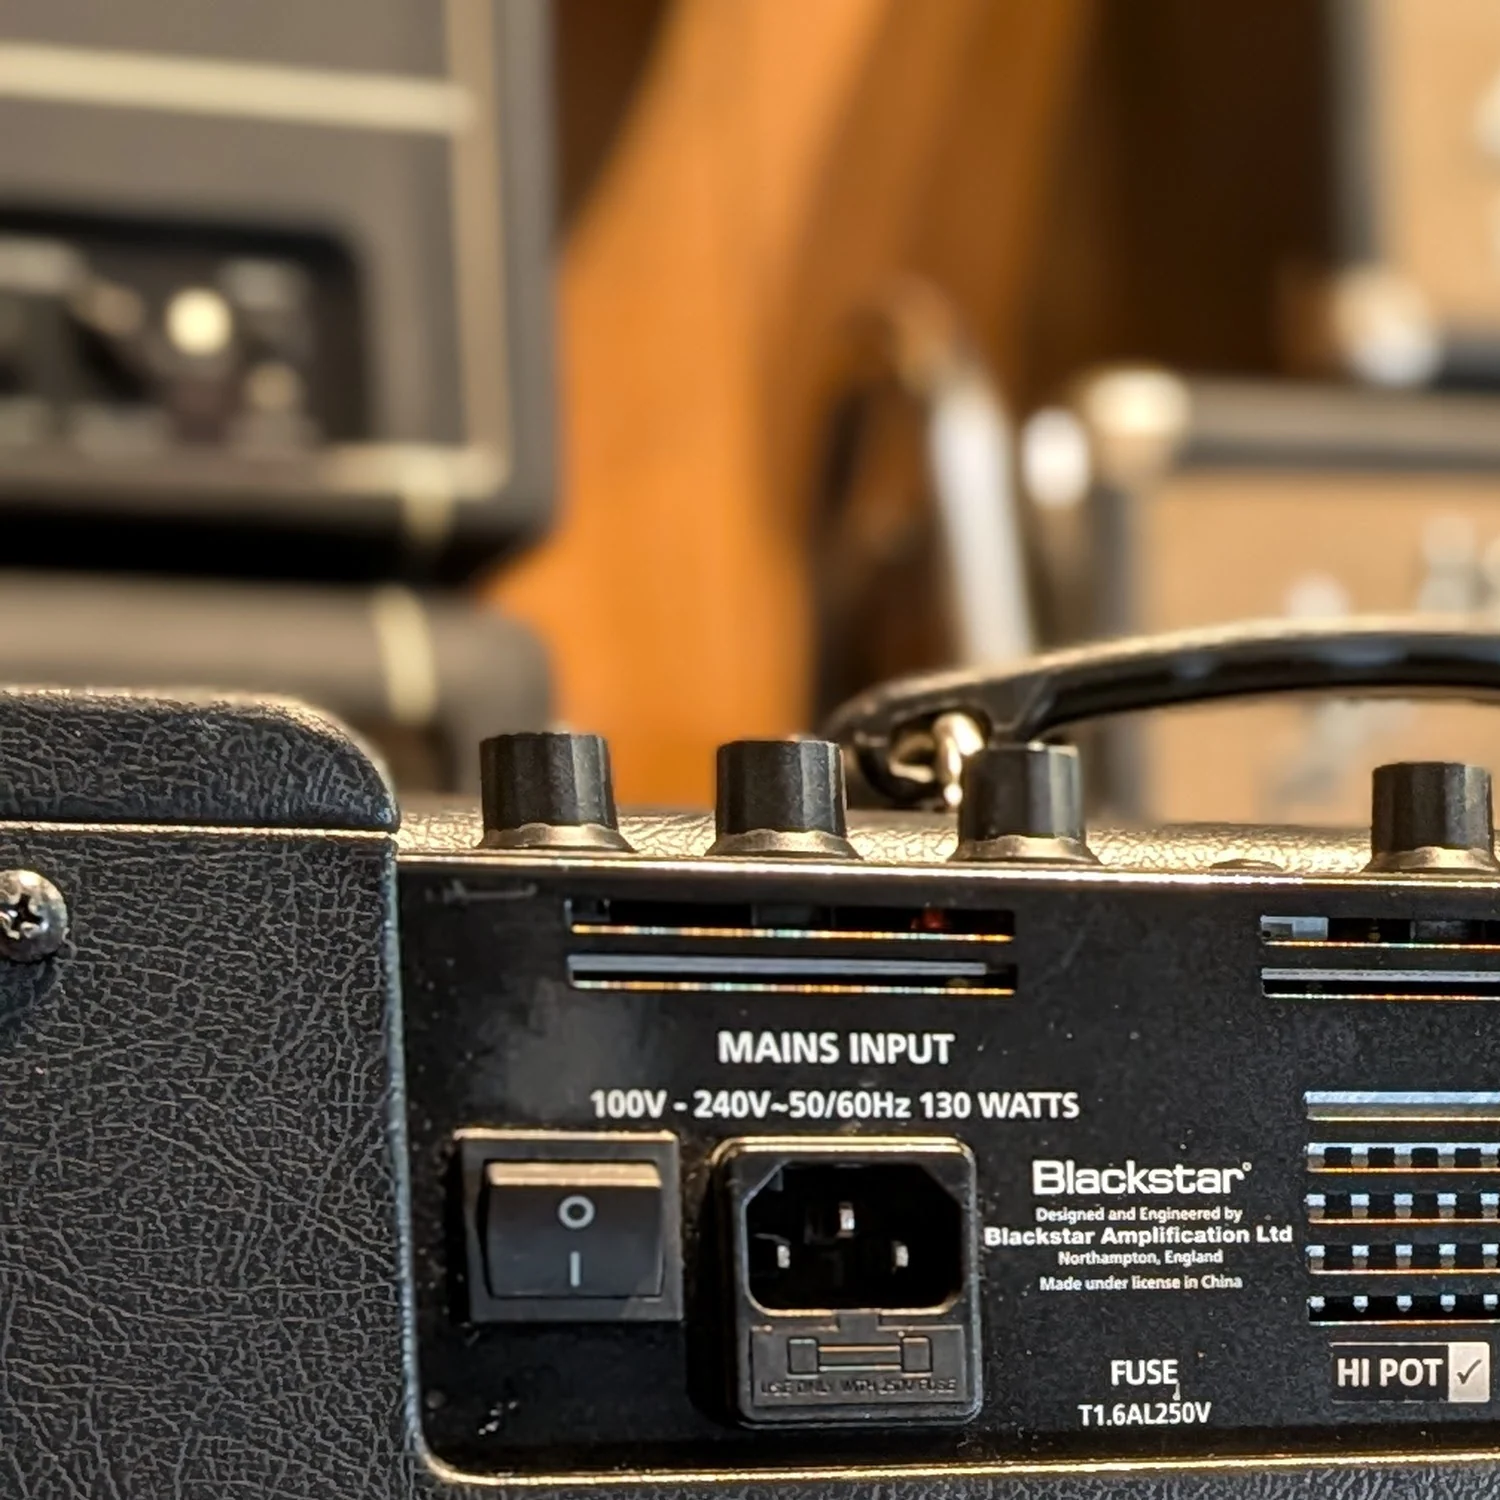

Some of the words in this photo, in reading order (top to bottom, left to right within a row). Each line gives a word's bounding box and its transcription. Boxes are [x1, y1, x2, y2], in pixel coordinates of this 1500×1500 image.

[718, 1032, 840, 1065] MAINS
[850, 1033, 955, 1065] INPUT
[591, 1090, 667, 1119] 100V
[921, 1091, 971, 1119] 130
[978, 1091, 1079, 1119] WATTS
[1035, 1207, 1104, 1224] Designed
[1108, 1207, 1136, 1221] and
[1139, 1207, 1221, 1223] Engineered
[1224, 1206, 1243, 1223] by
[983, 1227, 1095, 1246] Blackstar
[1101, 1225, 1250, 1248] Amplification
[1256, 1225, 1293, 1243] Ltd
[1058, 1250, 1161, 1268] Northampton,
[1165, 1249, 1224, 1267] England
[1040, 1276, 1082, 1291] Made
[1085, 1276, 1128, 1290] under
[1132, 1275, 1180, 1290] license
[1184, 1275, 1199, 1289] in
[1201, 1275, 1243, 1290] China
[1110, 1359, 1178, 1386] FUSE
[1337, 1358, 1370, 1387] HI
[1379, 1358, 1443, 1386] POT
[1078, 1402, 1212, 1426] T1.6AL250V
